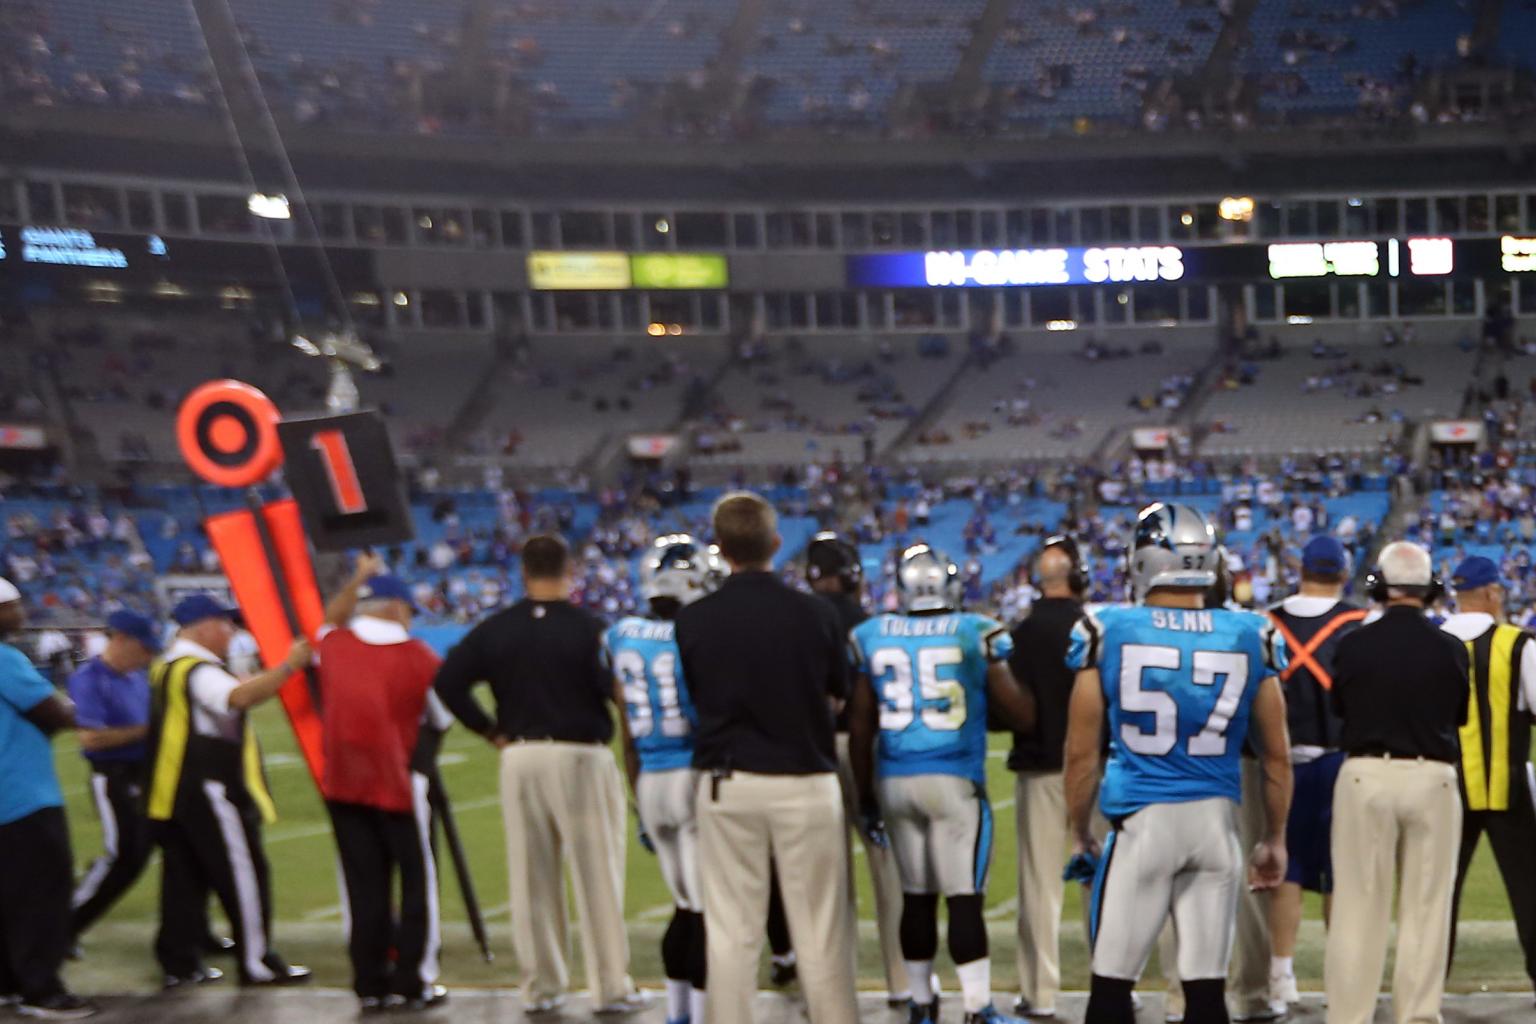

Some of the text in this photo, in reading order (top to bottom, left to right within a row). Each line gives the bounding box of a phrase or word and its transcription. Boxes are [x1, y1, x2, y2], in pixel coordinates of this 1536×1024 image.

[924, 246, 1184, 286] IN-GAME STATS
[310, 428, 369, 515] 1
[871, 646, 967, 731] 35
[1119, 643, 1249, 757] 57
